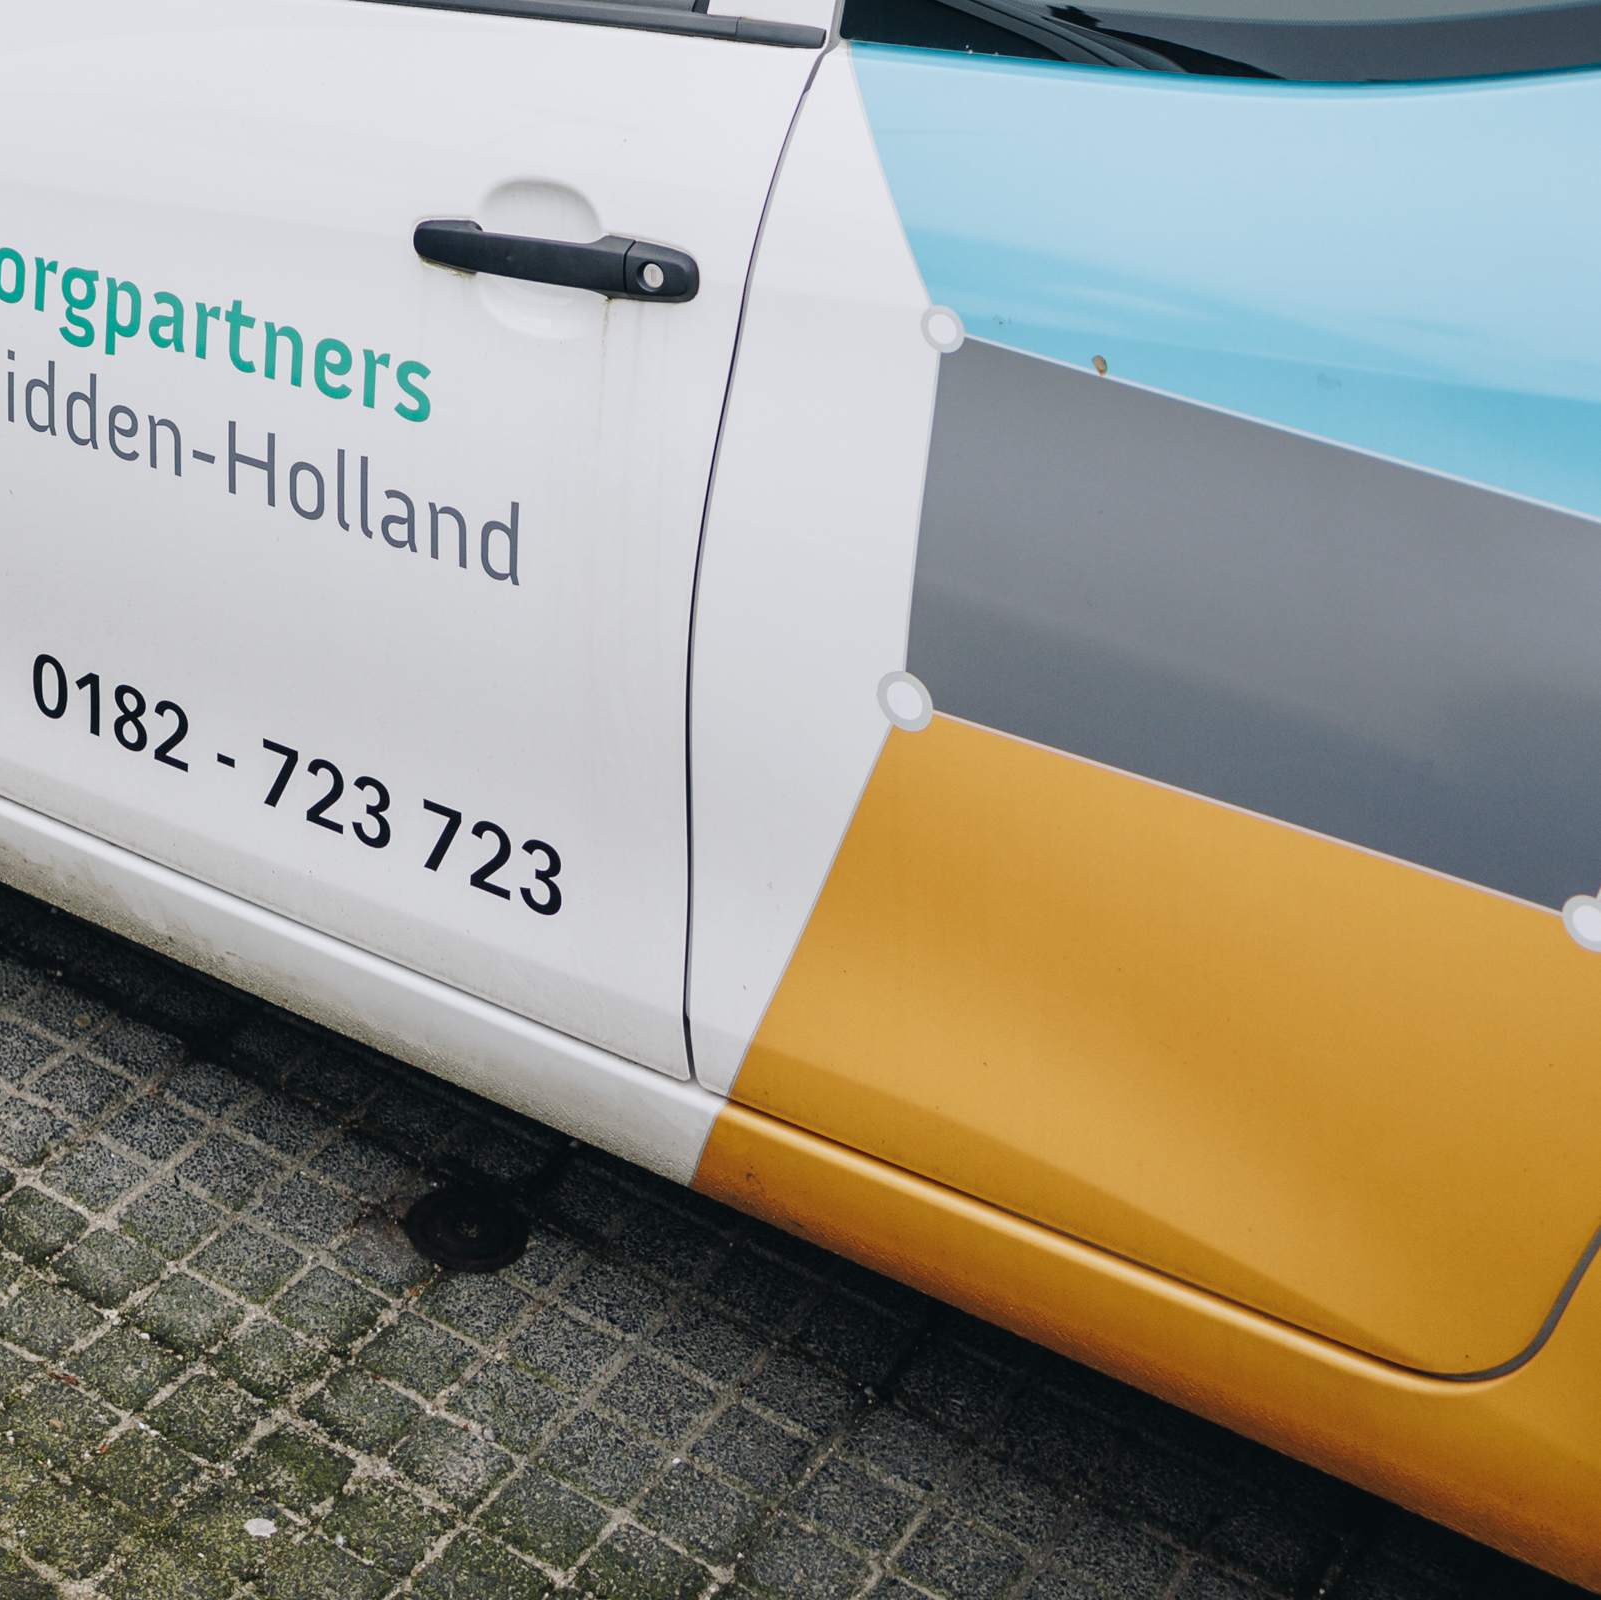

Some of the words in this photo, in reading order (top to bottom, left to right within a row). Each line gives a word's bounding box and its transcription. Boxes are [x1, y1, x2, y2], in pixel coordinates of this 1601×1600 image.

[32, 652, 190, 774] 0182
[262, 737, 392, 850] 723
[423, 797, 563, 917] 723
